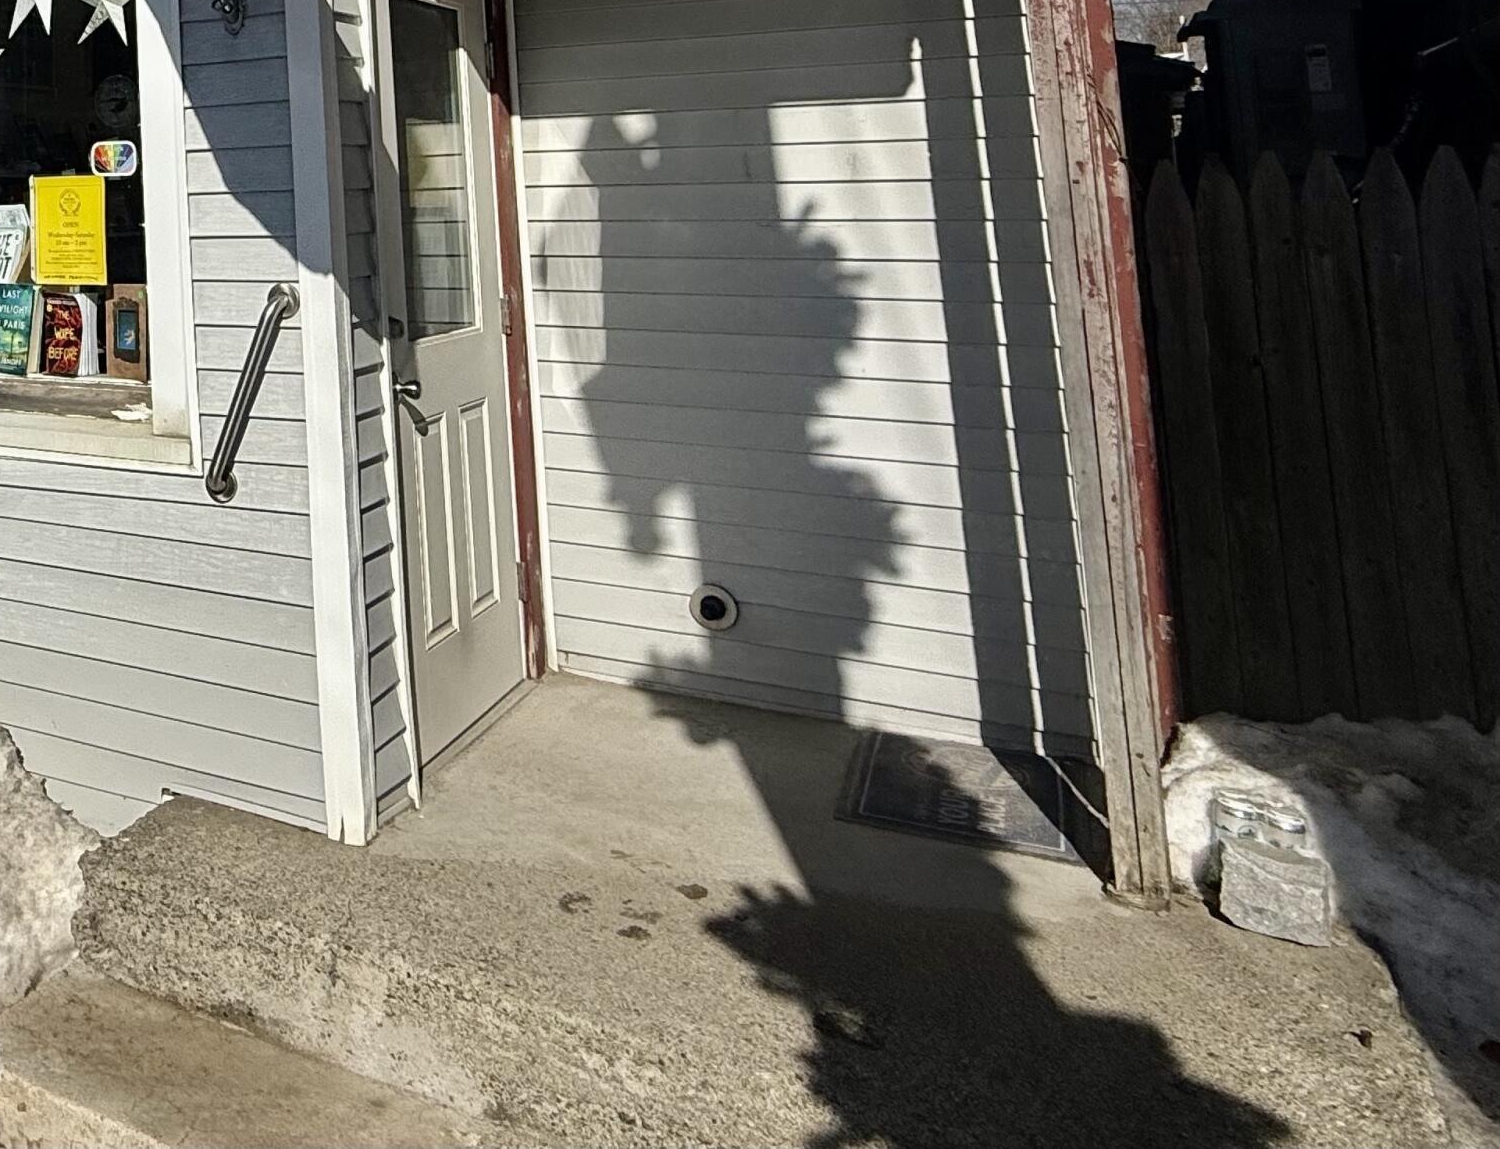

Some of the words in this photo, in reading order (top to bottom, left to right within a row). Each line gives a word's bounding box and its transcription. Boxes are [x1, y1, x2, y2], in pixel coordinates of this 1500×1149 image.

[2, 289, 21, 299] LAST
[2, 320, 26, 329] PARIS
[48, 346, 79, 361] BEFORE
